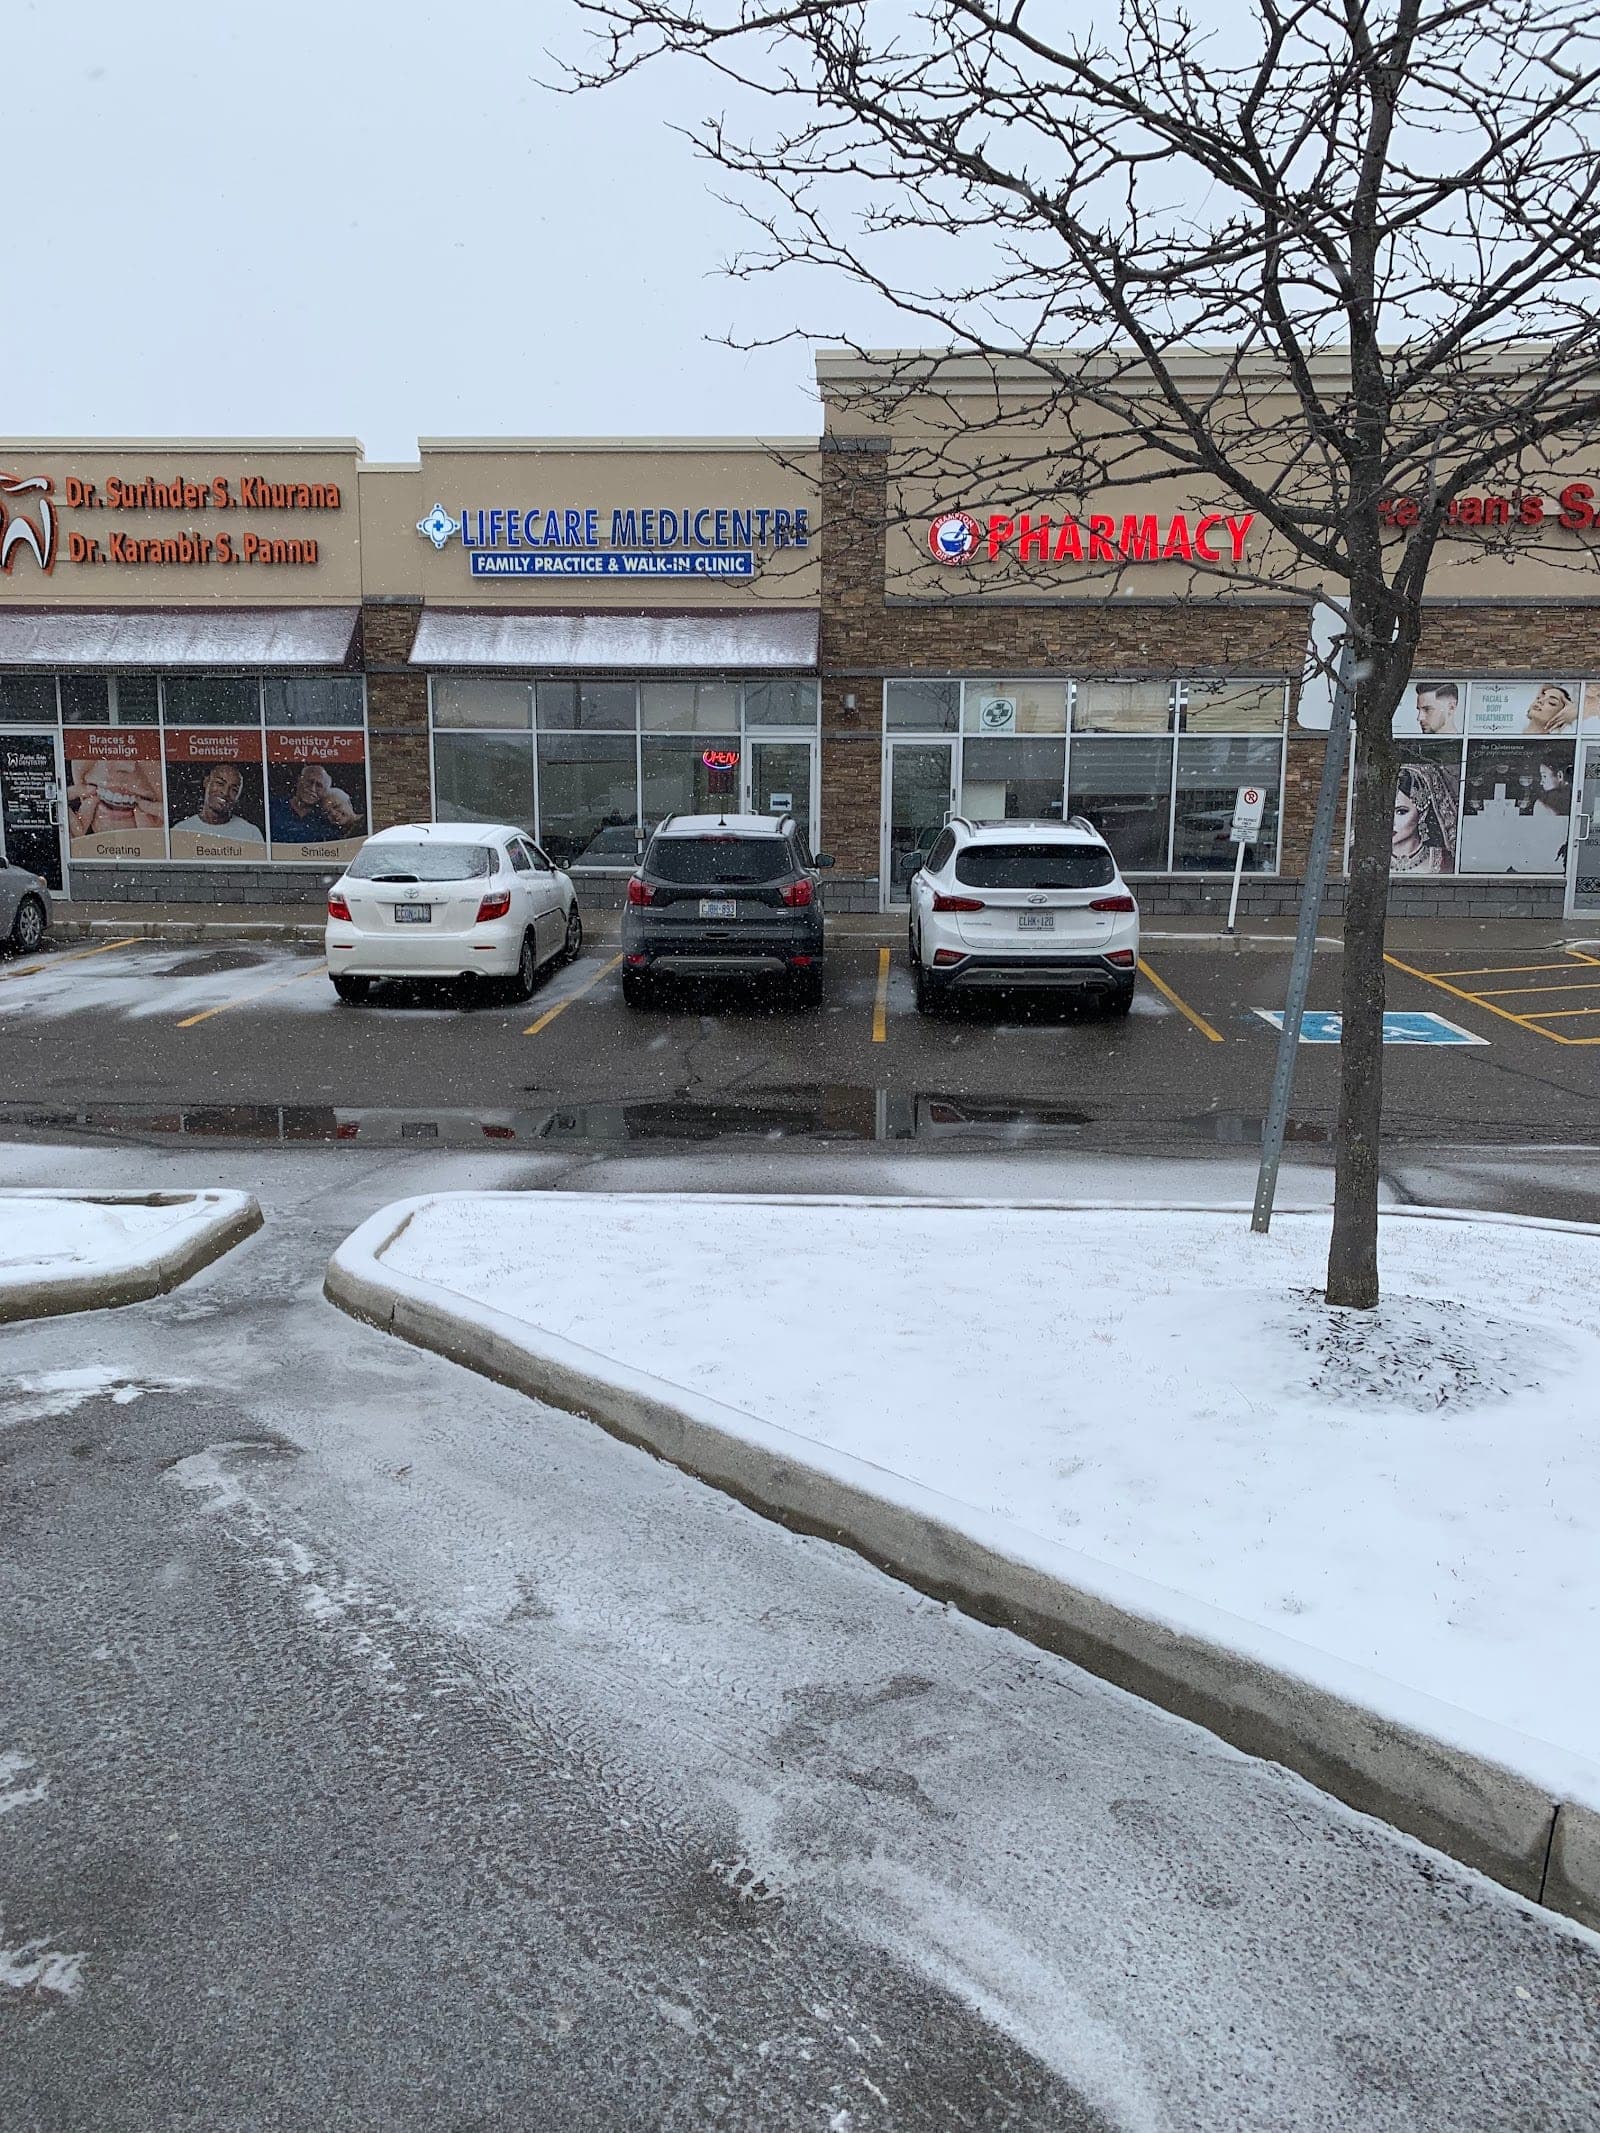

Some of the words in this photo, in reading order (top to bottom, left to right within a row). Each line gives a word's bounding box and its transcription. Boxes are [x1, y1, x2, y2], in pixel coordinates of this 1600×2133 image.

[66, 476, 102, 509] Dr.
[106, 475, 209, 509] Surinder
[212, 476, 237, 509] S.
[240, 475, 341, 509] Khurana
[1560, 482, 1600, 530] S
[461, 507, 600, 548] LIFECARE
[610, 507, 810, 548] MEDICENTRE
[987, 513, 1255, 563] PHARMACY
[69, 531, 105, 564] Dr.
[109, 530, 212, 564] Karanbir
[215, 532, 240, 564] S.
[243, 531, 318, 564] Pannu
[478, 556, 531, 572] FAMILY
[535, 556, 603, 572] PRACTICE
[608, 556, 619, 572] &
[624, 556, 691, 572] WALK-IN
[695, 556, 745, 573] CLINIC
[89, 734, 125, 746] Braces
[127, 734, 137, 746] &
[189, 735, 239, 746] Cosmetic
[280, 735, 330, 748] Dentistry
[333, 735, 352, 747] For
[88, 744, 138, 757] Invisalign
[189, 745, 240, 758] Dentistry
[294, 746, 308, 757] All
[311, 746, 339, 759] Ages
[705, 750, 736, 764] OPEN
[96, 844, 141, 858] Creating
[195, 845, 242, 857] Beautiful
[301, 846, 340, 858] Smiles!
